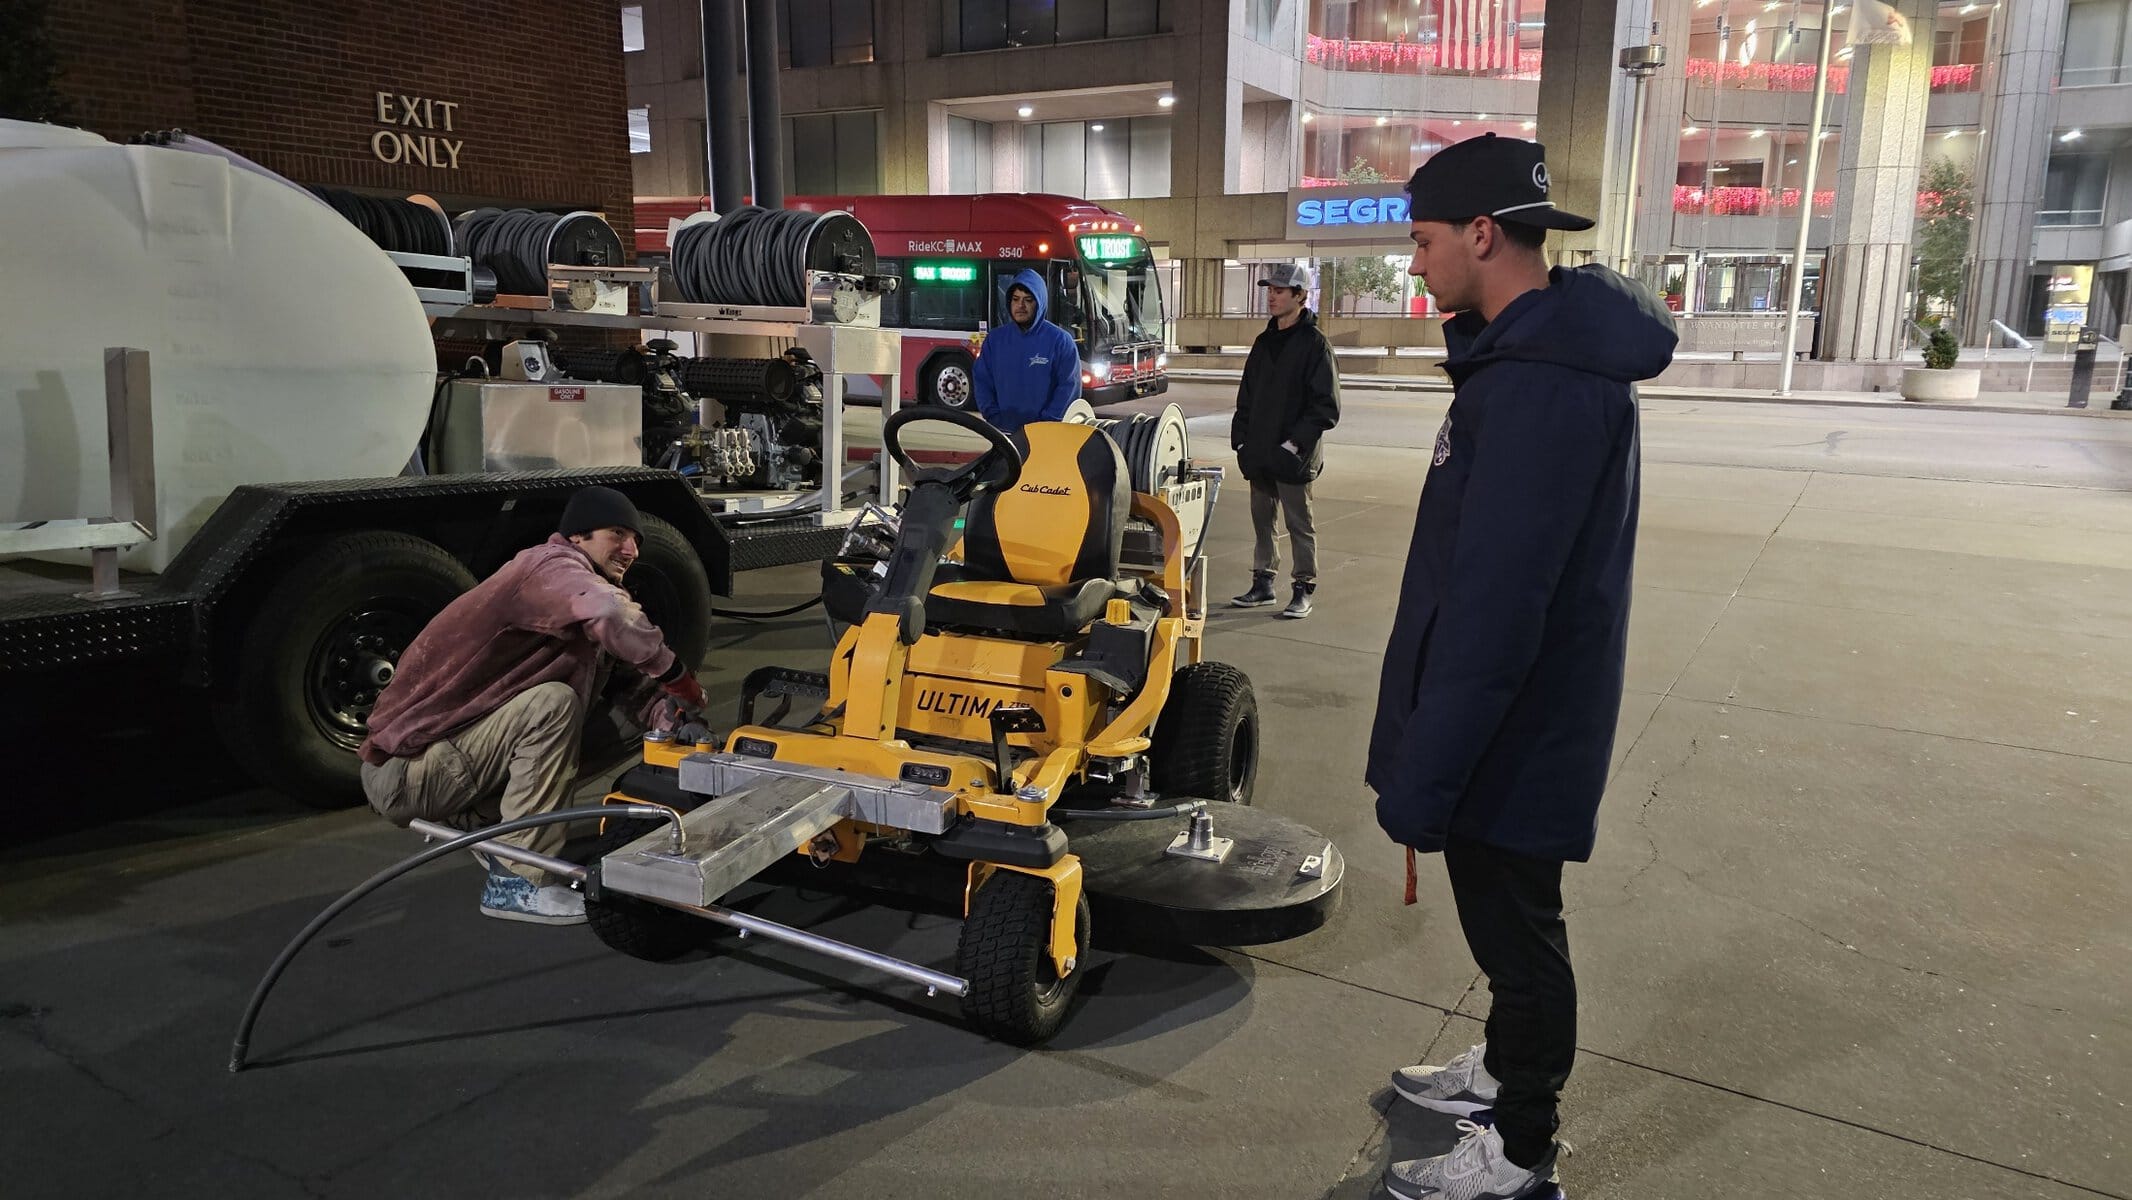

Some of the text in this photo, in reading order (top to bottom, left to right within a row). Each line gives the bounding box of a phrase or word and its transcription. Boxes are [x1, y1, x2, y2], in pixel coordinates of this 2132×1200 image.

[376, 91, 459, 132] EXIT
[371, 130, 464, 169] ONLY
[1296, 198, 1411, 225] SEGR
[908, 240, 983, 253] RideKC MAX
[999, 247, 1022, 258] 3540
[1020, 483, 1071, 496] Cub Cadet
